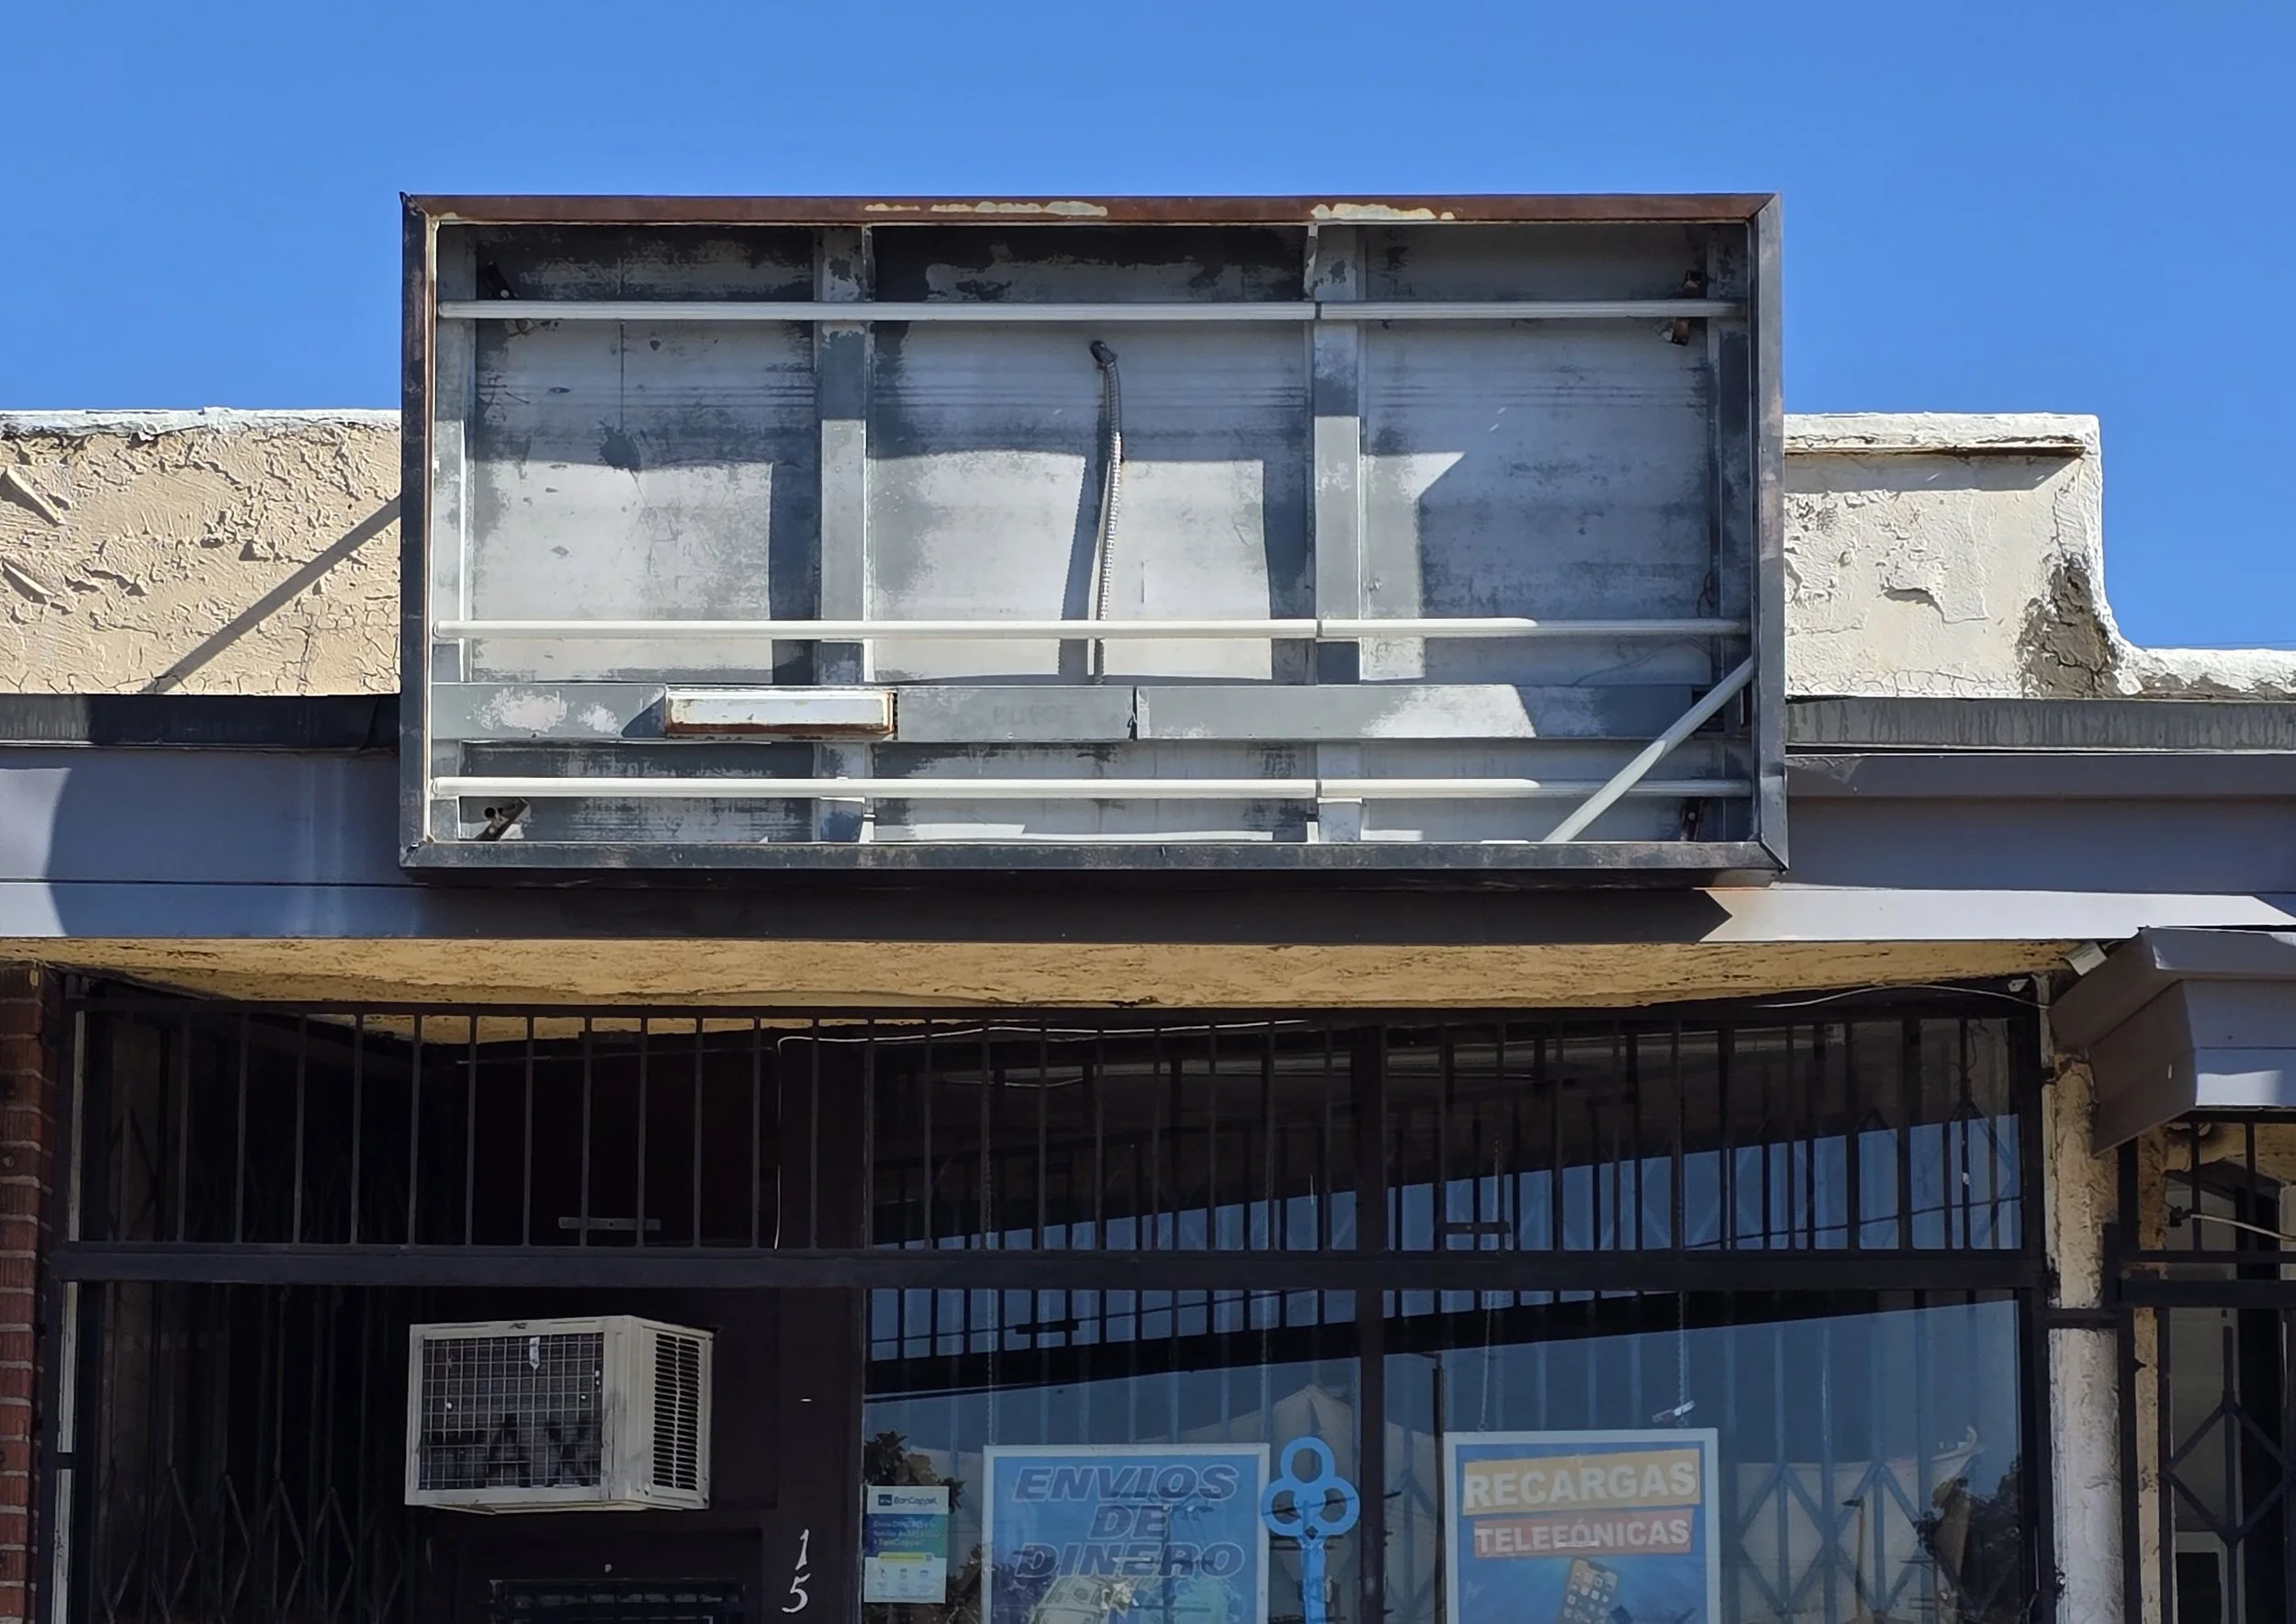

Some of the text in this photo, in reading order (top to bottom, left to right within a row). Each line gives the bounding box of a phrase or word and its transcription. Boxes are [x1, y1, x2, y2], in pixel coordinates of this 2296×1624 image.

[1012, 1464, 1238, 1502] ENVIOS
[1465, 1461, 1697, 1509] RECARGAS
[1087, 1503, 1172, 1539] DE
[1474, 1517, 1690, 1553] TELEFÓNICAS
[1014, 1542, 1246, 1578] DINERO
